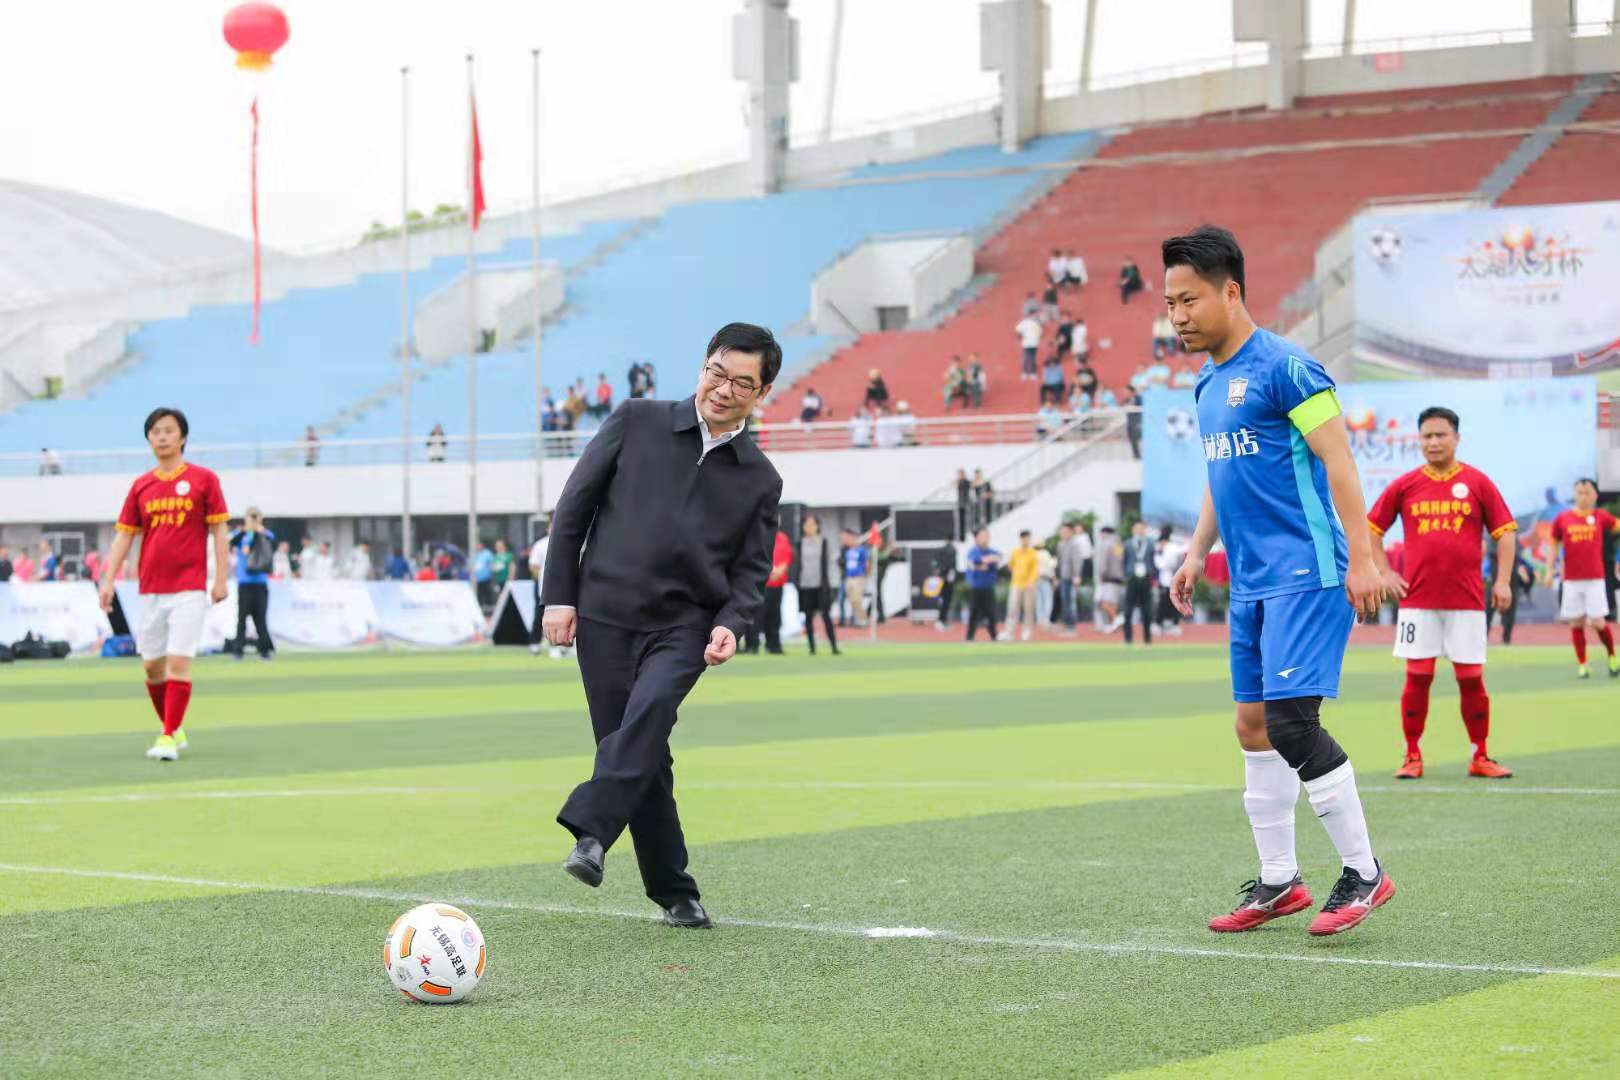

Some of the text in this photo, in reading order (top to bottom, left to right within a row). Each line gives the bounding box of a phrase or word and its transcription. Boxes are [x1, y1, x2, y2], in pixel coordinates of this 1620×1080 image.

[1400, 621, 1416, 643] 18
[430, 924, 467, 978] 无锡高足联
